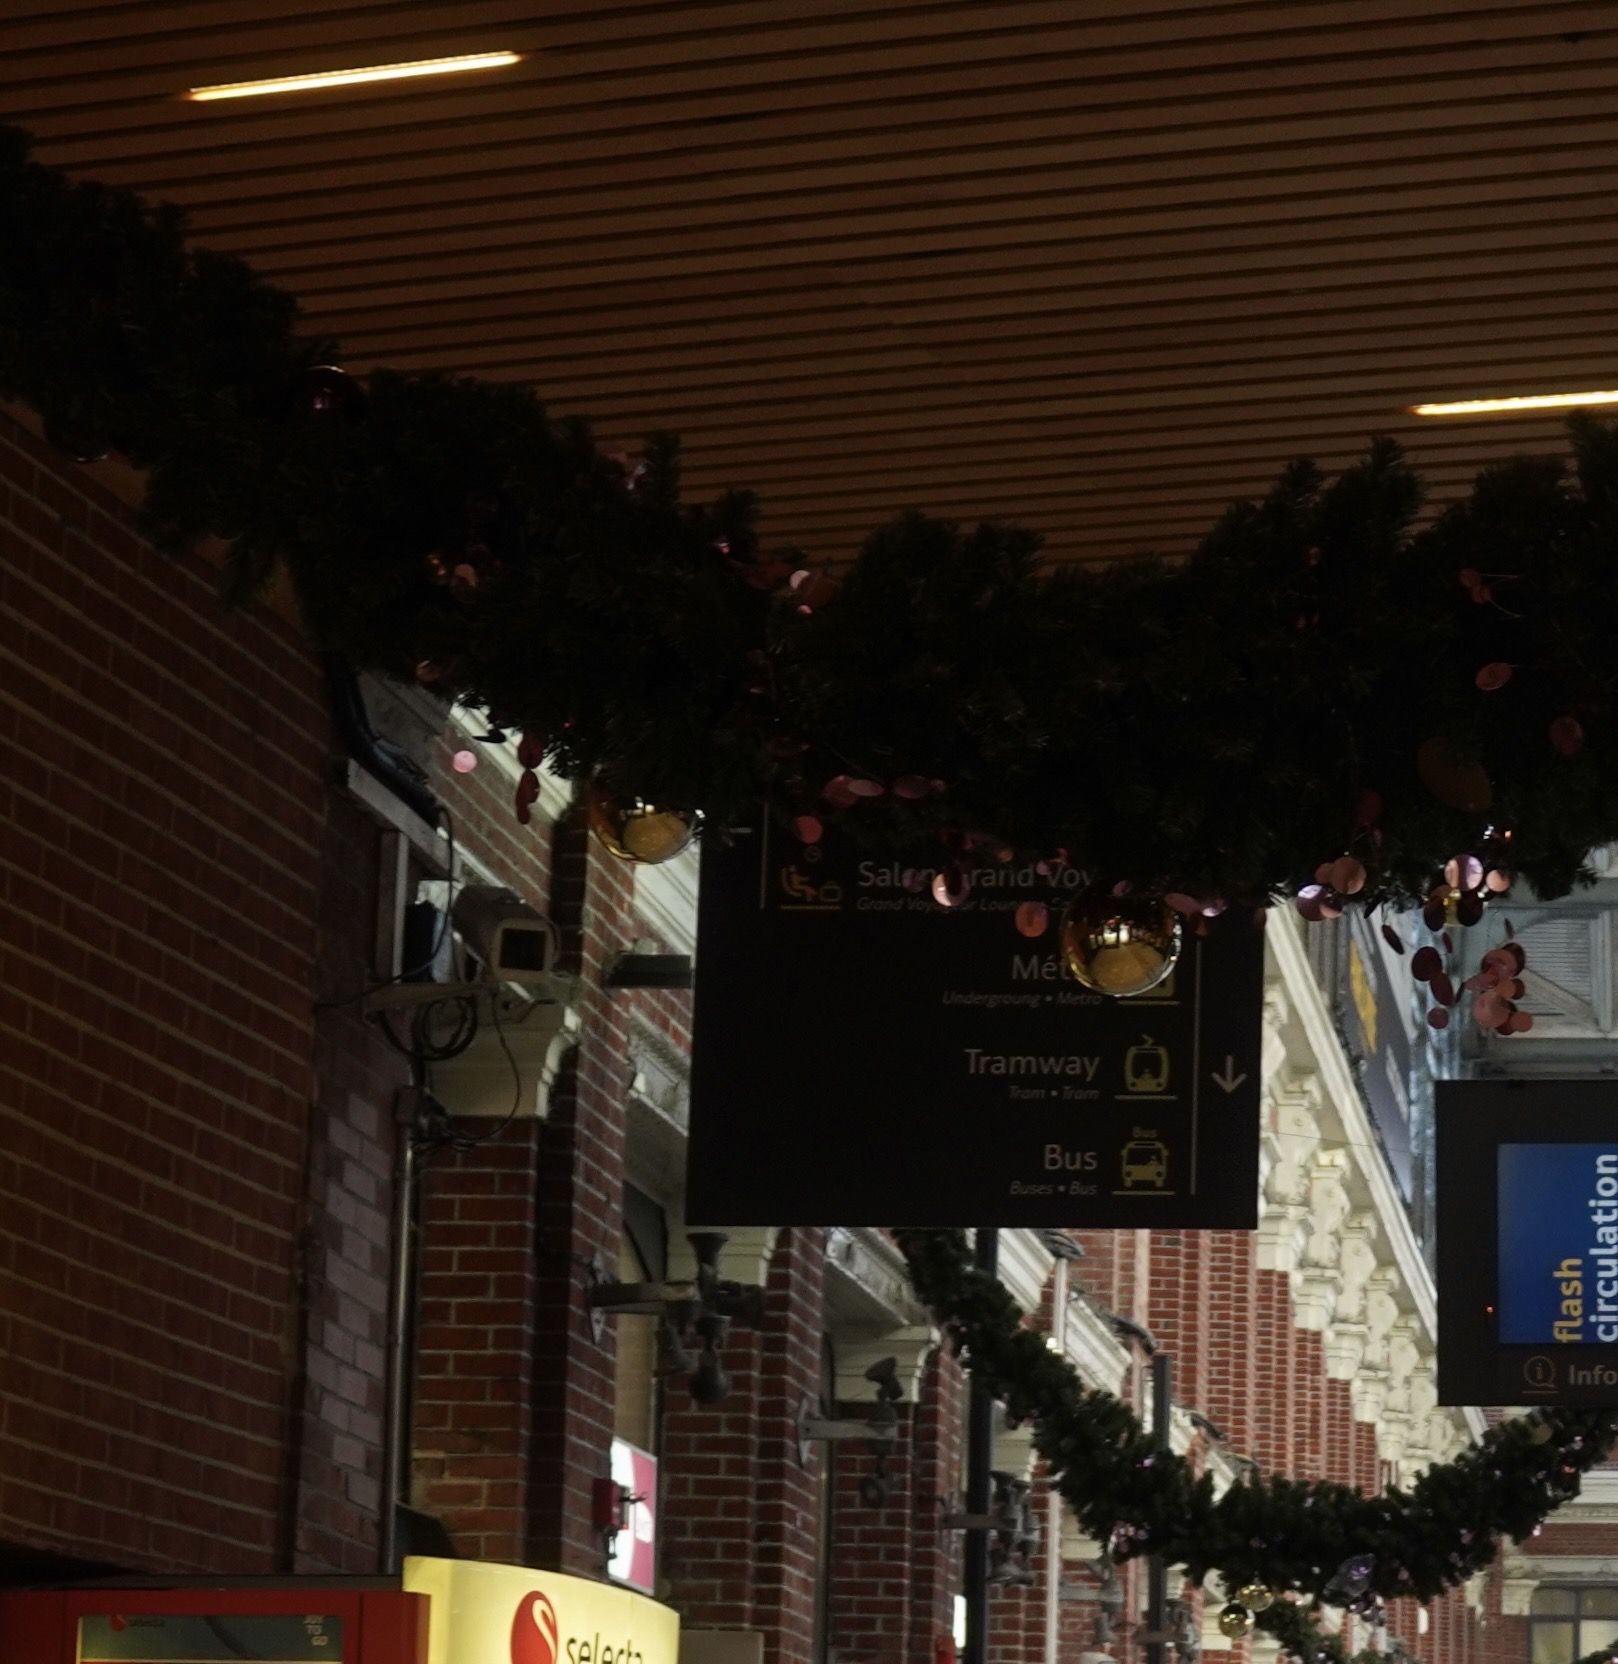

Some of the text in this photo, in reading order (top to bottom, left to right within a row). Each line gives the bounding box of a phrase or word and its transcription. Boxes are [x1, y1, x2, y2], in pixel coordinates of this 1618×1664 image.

[963, 1048, 1100, 1081] Tramway
[1132, 1126, 1158, 1137] Bus
[1043, 1144, 1098, 1170] Bus
[1009, 1180, 1098, 1195] Buses Bus
[1588, 1153, 1618, 1342] circulation
[1553, 1257, 1583, 1343] flash
